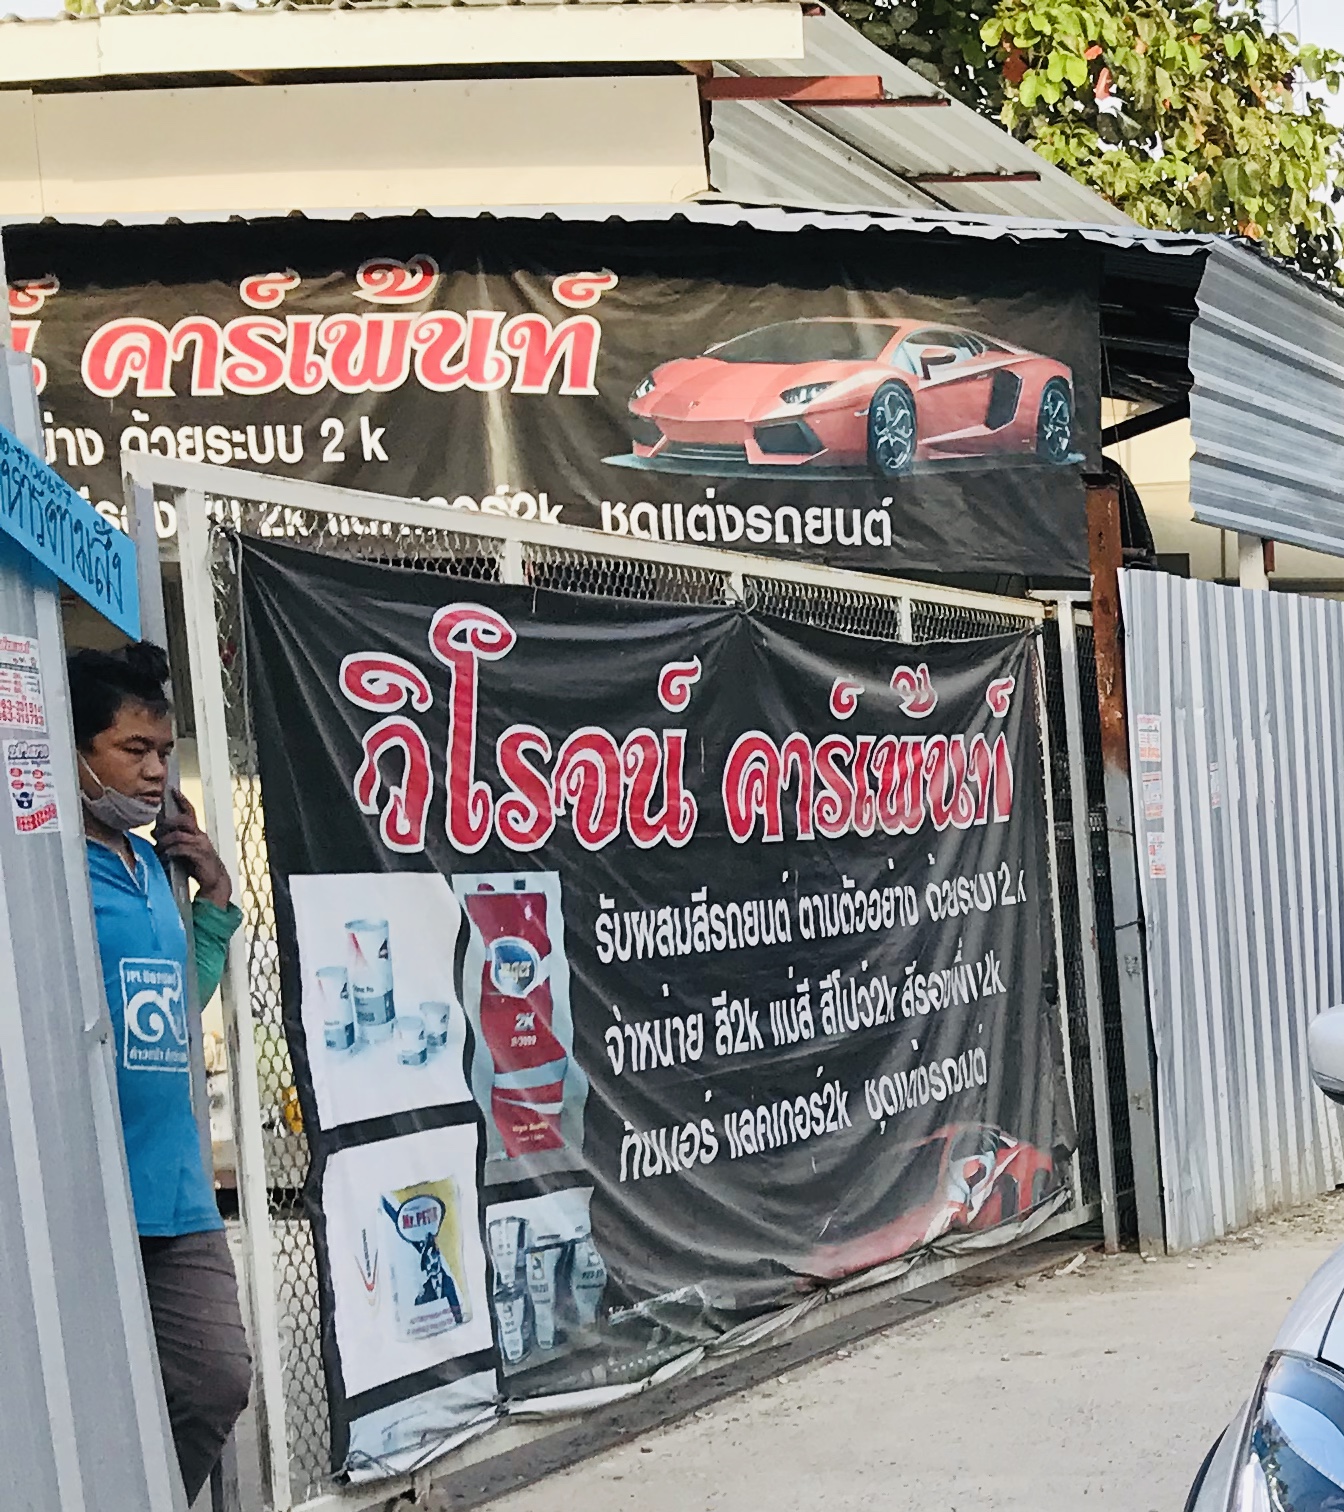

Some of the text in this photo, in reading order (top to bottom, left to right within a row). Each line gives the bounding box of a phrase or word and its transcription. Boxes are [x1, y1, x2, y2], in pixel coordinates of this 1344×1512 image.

[601, 487, 893, 547] ชดแต่งรถยนต์
[339, 602, 701, 854] วิโรจน์
